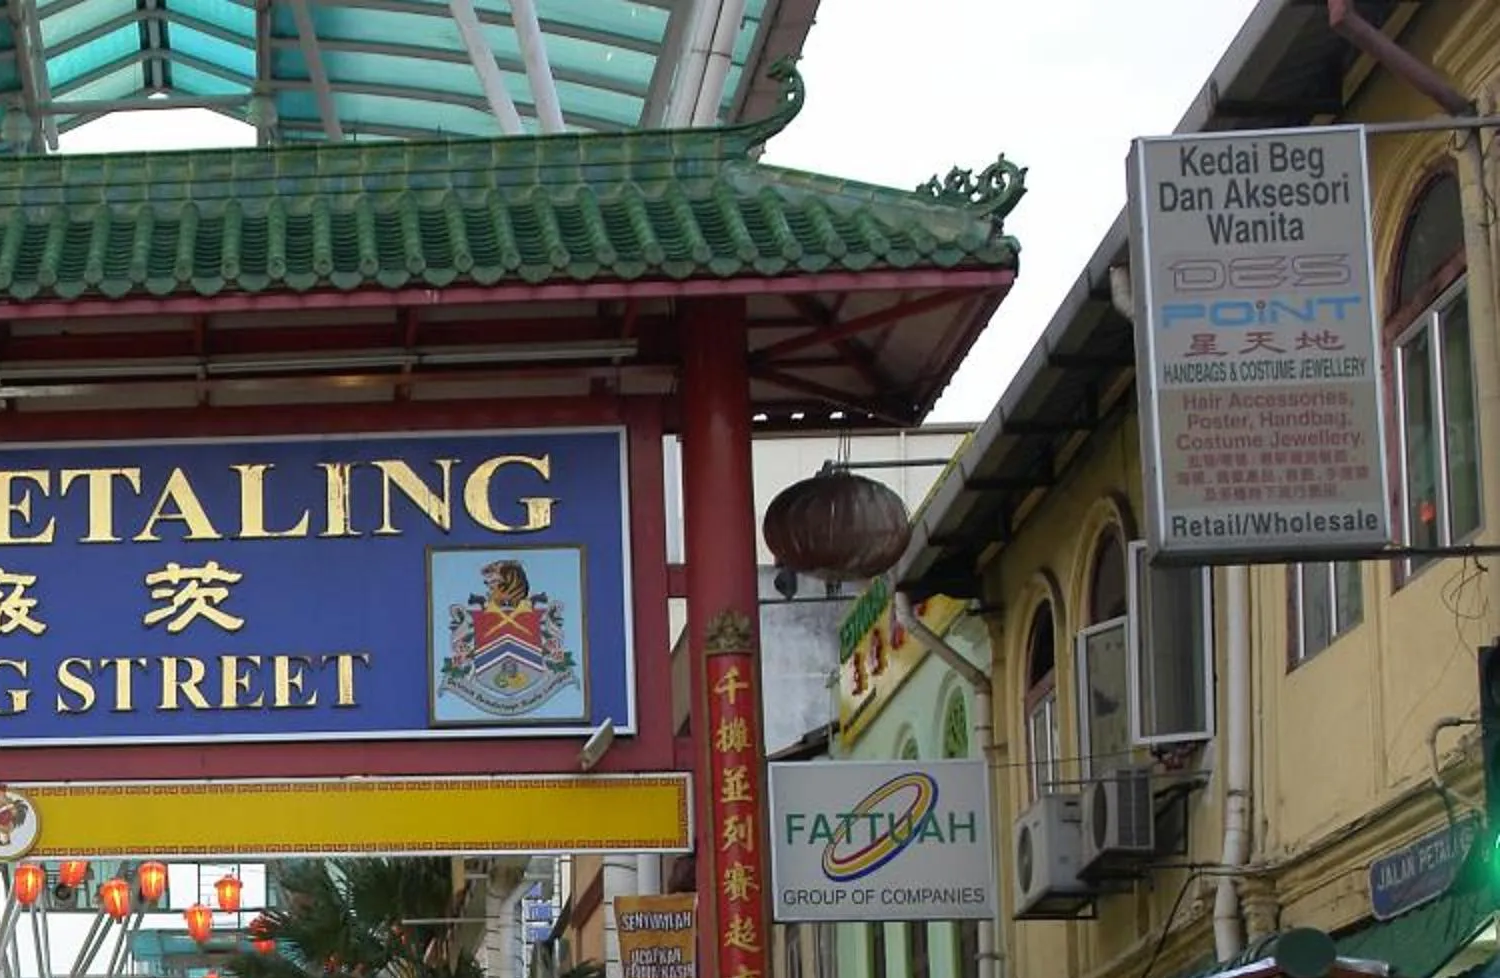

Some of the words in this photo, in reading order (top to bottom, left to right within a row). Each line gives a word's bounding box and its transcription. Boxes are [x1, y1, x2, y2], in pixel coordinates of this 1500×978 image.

[1180, 145, 1258, 178] Kedai
[1269, 142, 1325, 178] Beg
[1159, 182, 1213, 212] Dan
[1223, 175, 1349, 210] Aksesori
[1207, 212, 1304, 246] Wanita
[1168, 254, 1350, 291] DES
[1183, 330, 1345, 358] 星天地
[1164, 361, 1226, 384] HANDBAGS
[1230, 361, 1238, 382] &
[1240, 359, 1295, 382] COSTUME
[1300, 356, 1367, 379] JEWELLERY
[1183, 392, 1222, 411] Hair
[1176, 433, 1264, 451] Costume
[1173, 511, 1378, 539] Retail/Wholesale
[55, 653, 371, 714] STREET
[785, 811, 977, 846] FATTUAH
[1378, 857, 1415, 890] JALAN
[783, 889, 846, 905] GROUP
[851, 889, 875, 905] OF
[881, 887, 985, 904] COMPANIES
